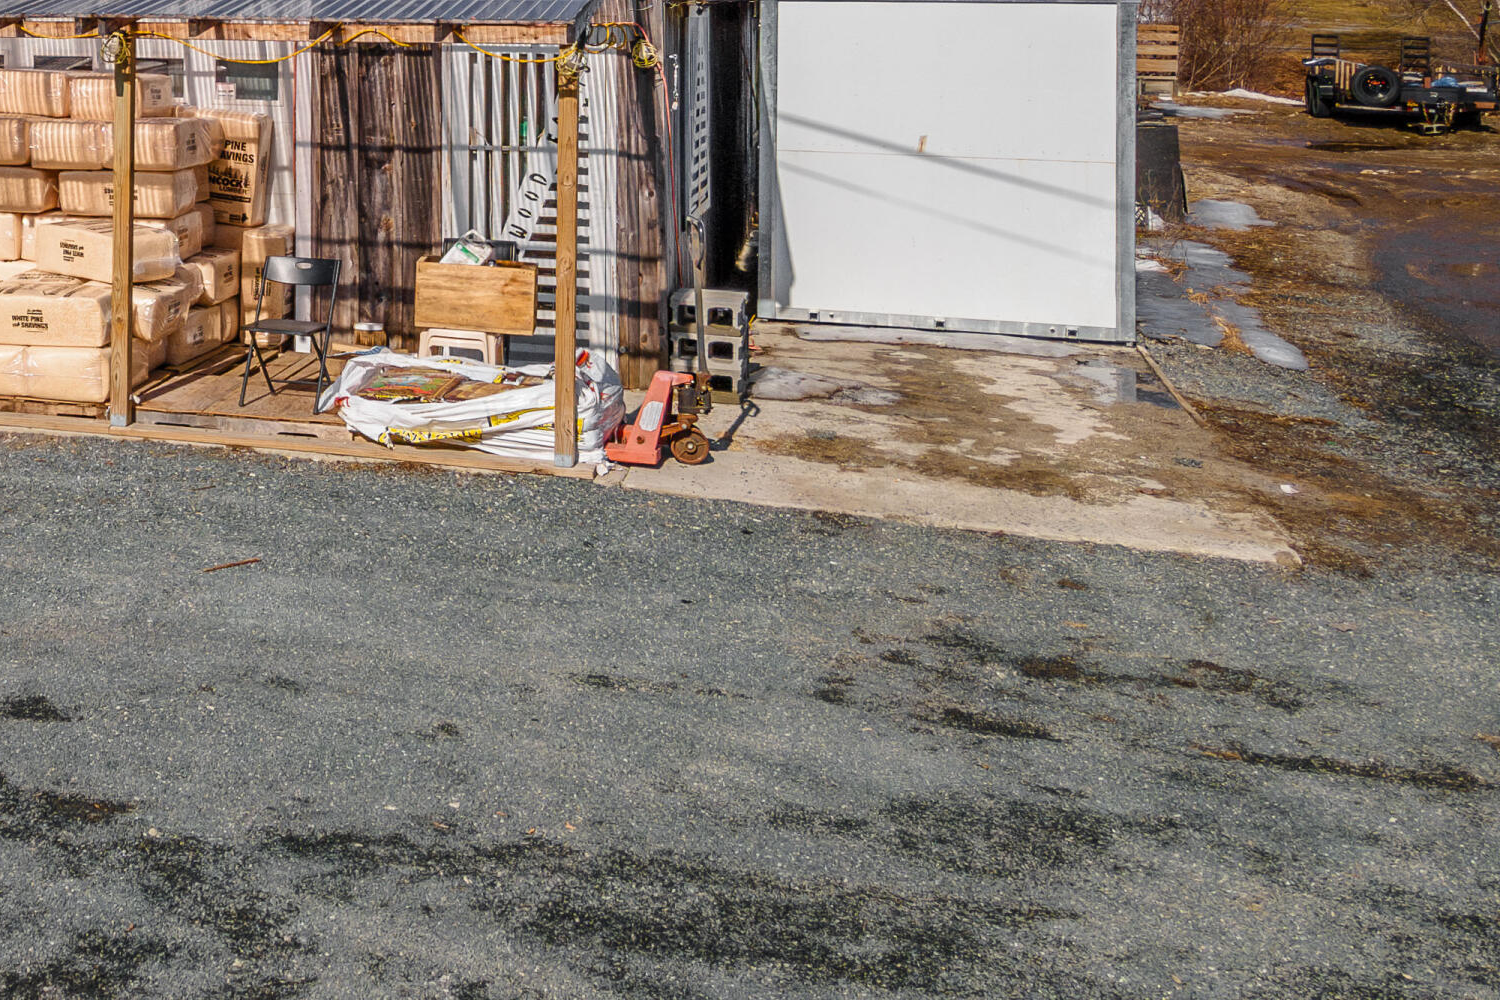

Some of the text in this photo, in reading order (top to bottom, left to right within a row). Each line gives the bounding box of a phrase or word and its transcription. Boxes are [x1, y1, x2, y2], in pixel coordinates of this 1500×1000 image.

[224, 140, 247, 151] PINE
[220, 150, 255, 163] AVINGS
[208, 175, 244, 188] NCOCK
[508, 172, 548, 240] WOOD
